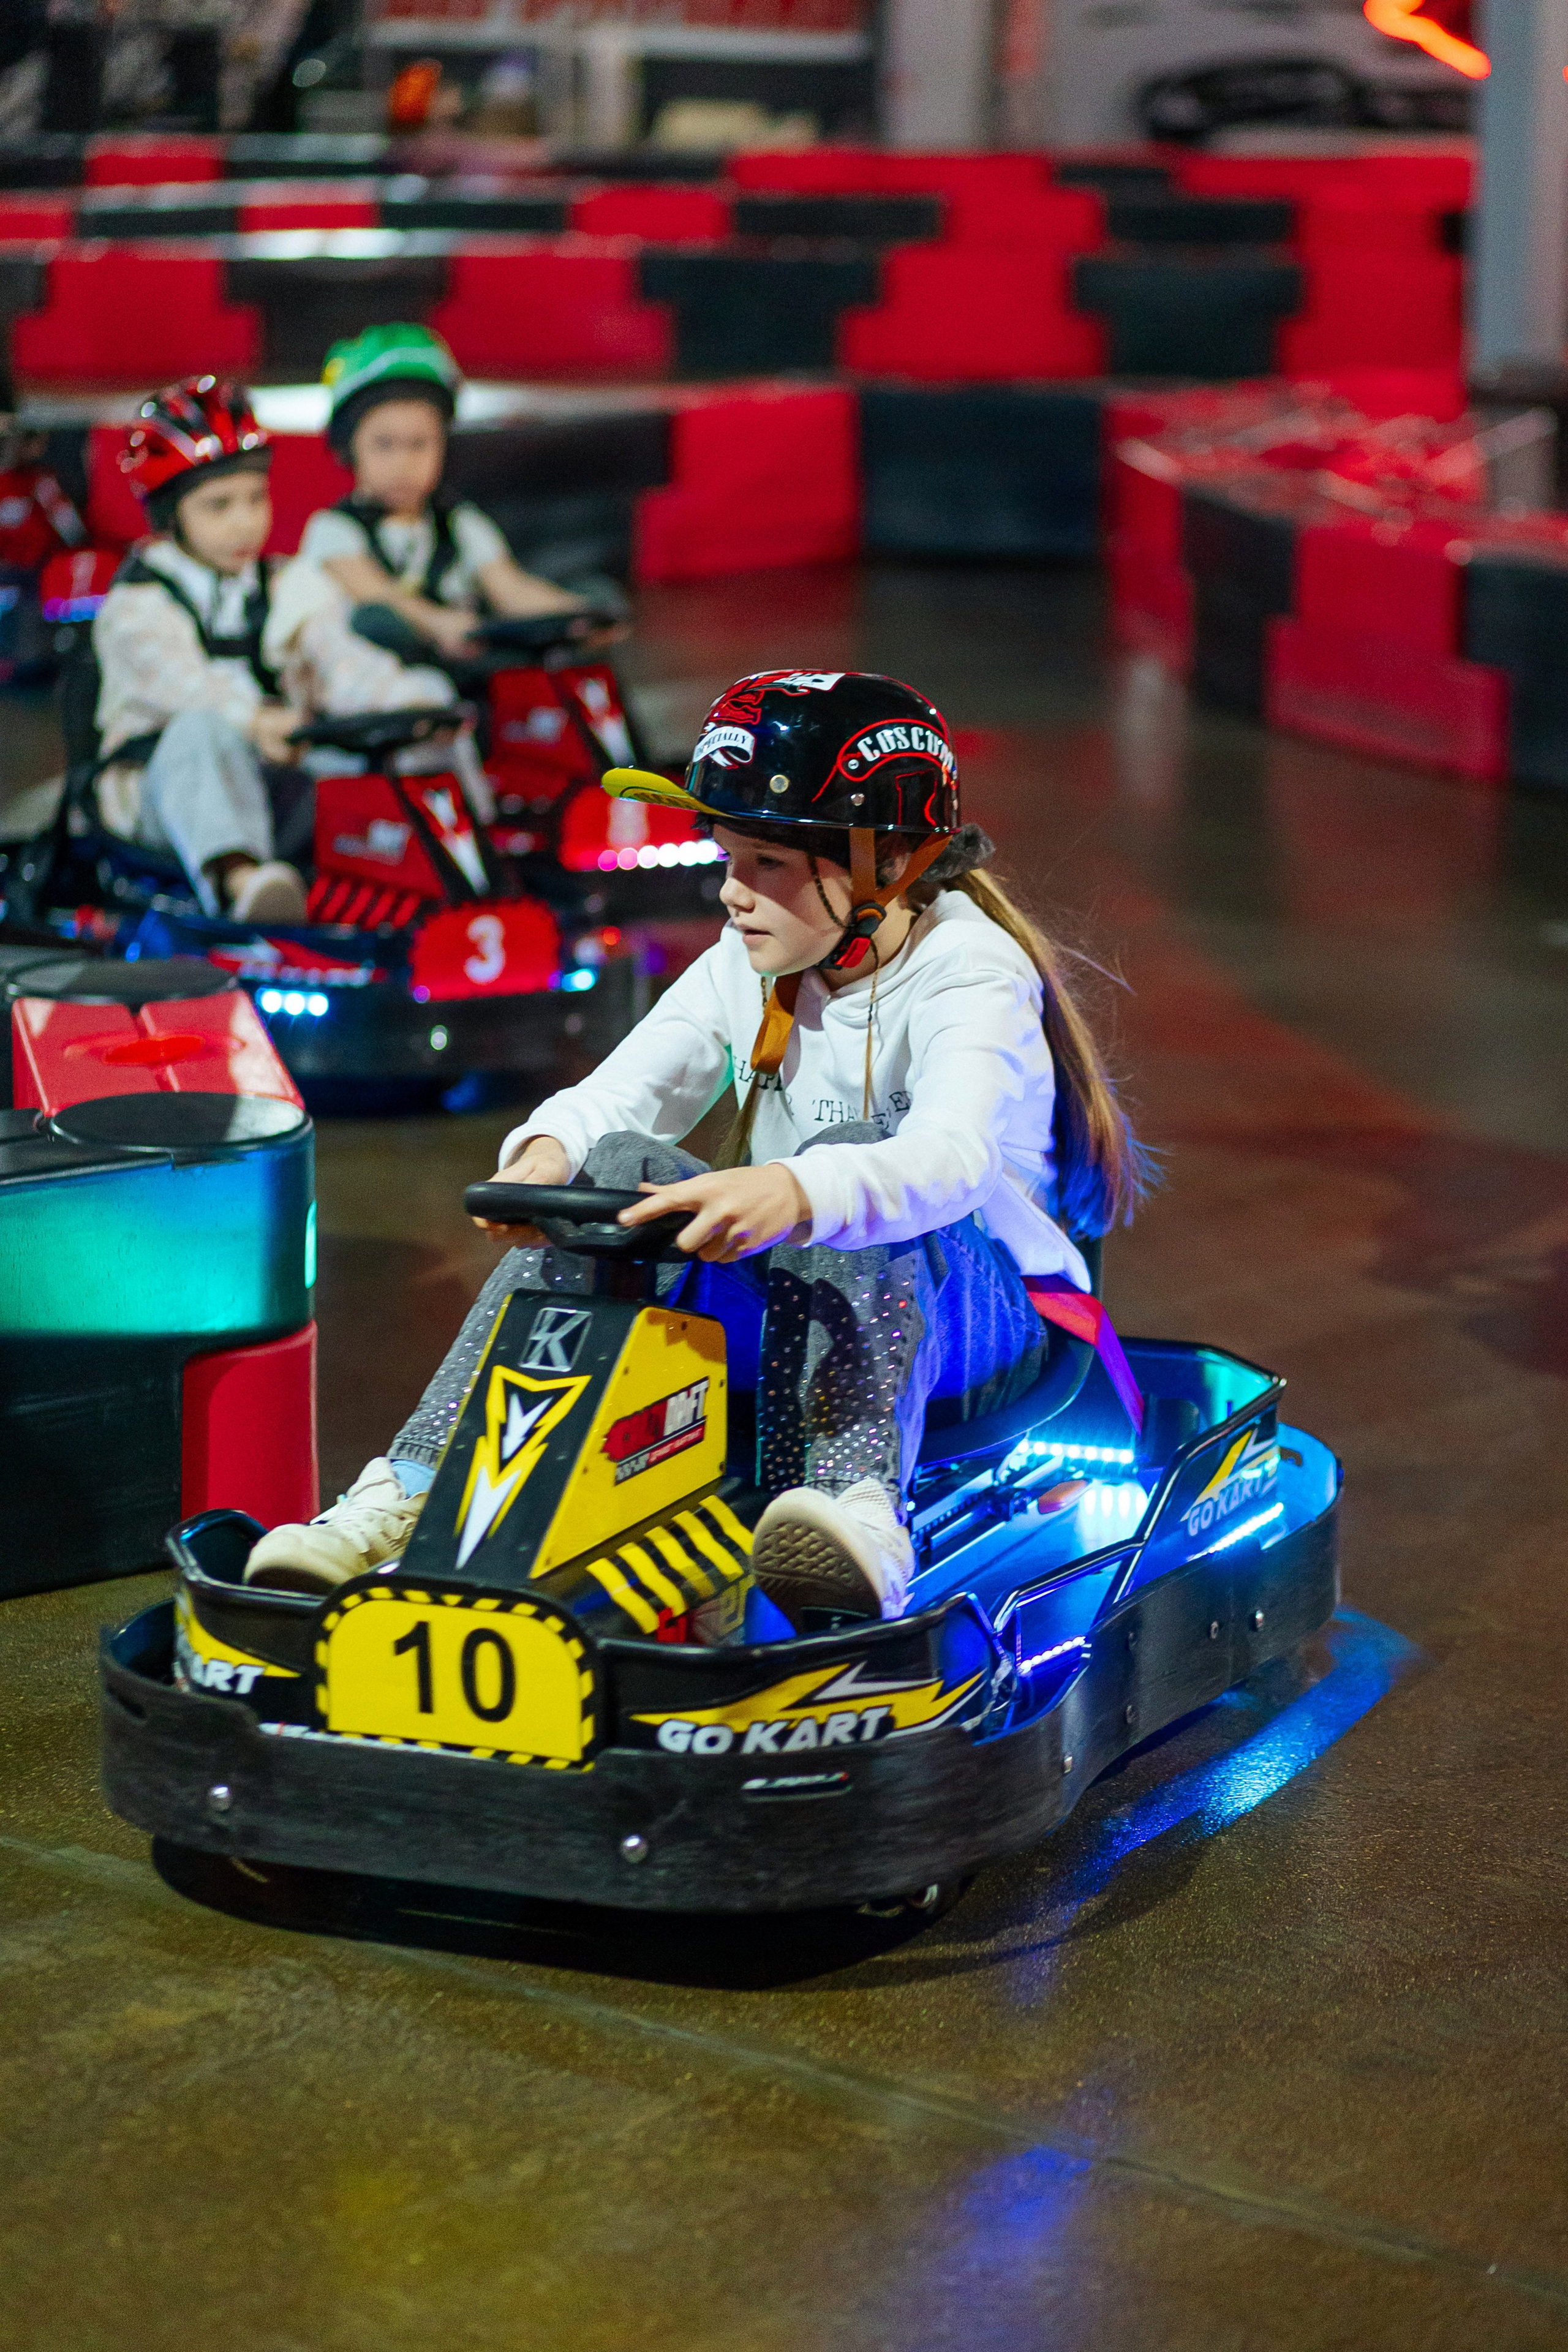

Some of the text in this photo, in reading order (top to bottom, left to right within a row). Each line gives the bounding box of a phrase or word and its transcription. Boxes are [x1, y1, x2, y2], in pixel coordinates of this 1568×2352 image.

[464, 914, 506, 984] 3
[1189, 1498, 1214, 1536] GO
[394, 1621, 516, 1723] 10
[657, 1706, 892, 1754] GO KART
